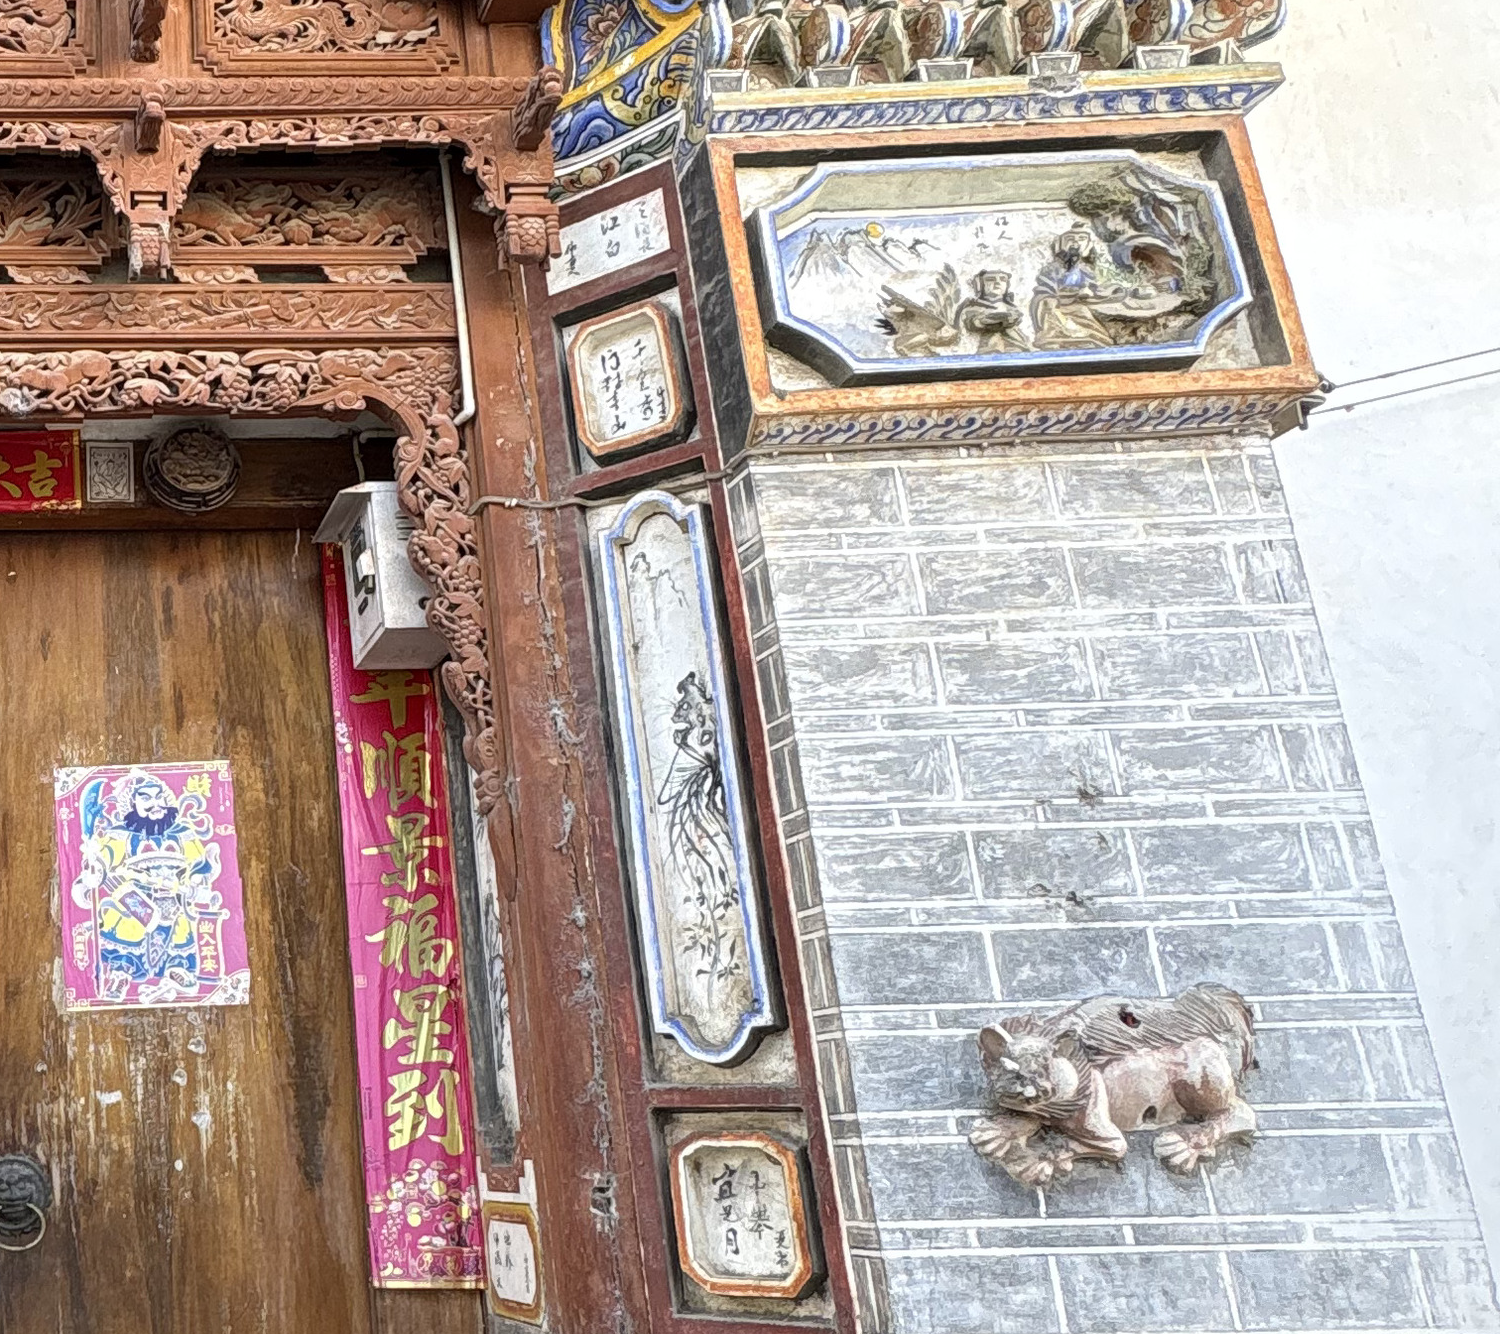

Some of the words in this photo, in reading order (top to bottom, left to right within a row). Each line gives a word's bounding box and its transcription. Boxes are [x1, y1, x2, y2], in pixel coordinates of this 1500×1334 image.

[199, 920, 218, 973] 出入平安
[350, 670, 465, 1156] 年順景福星到
